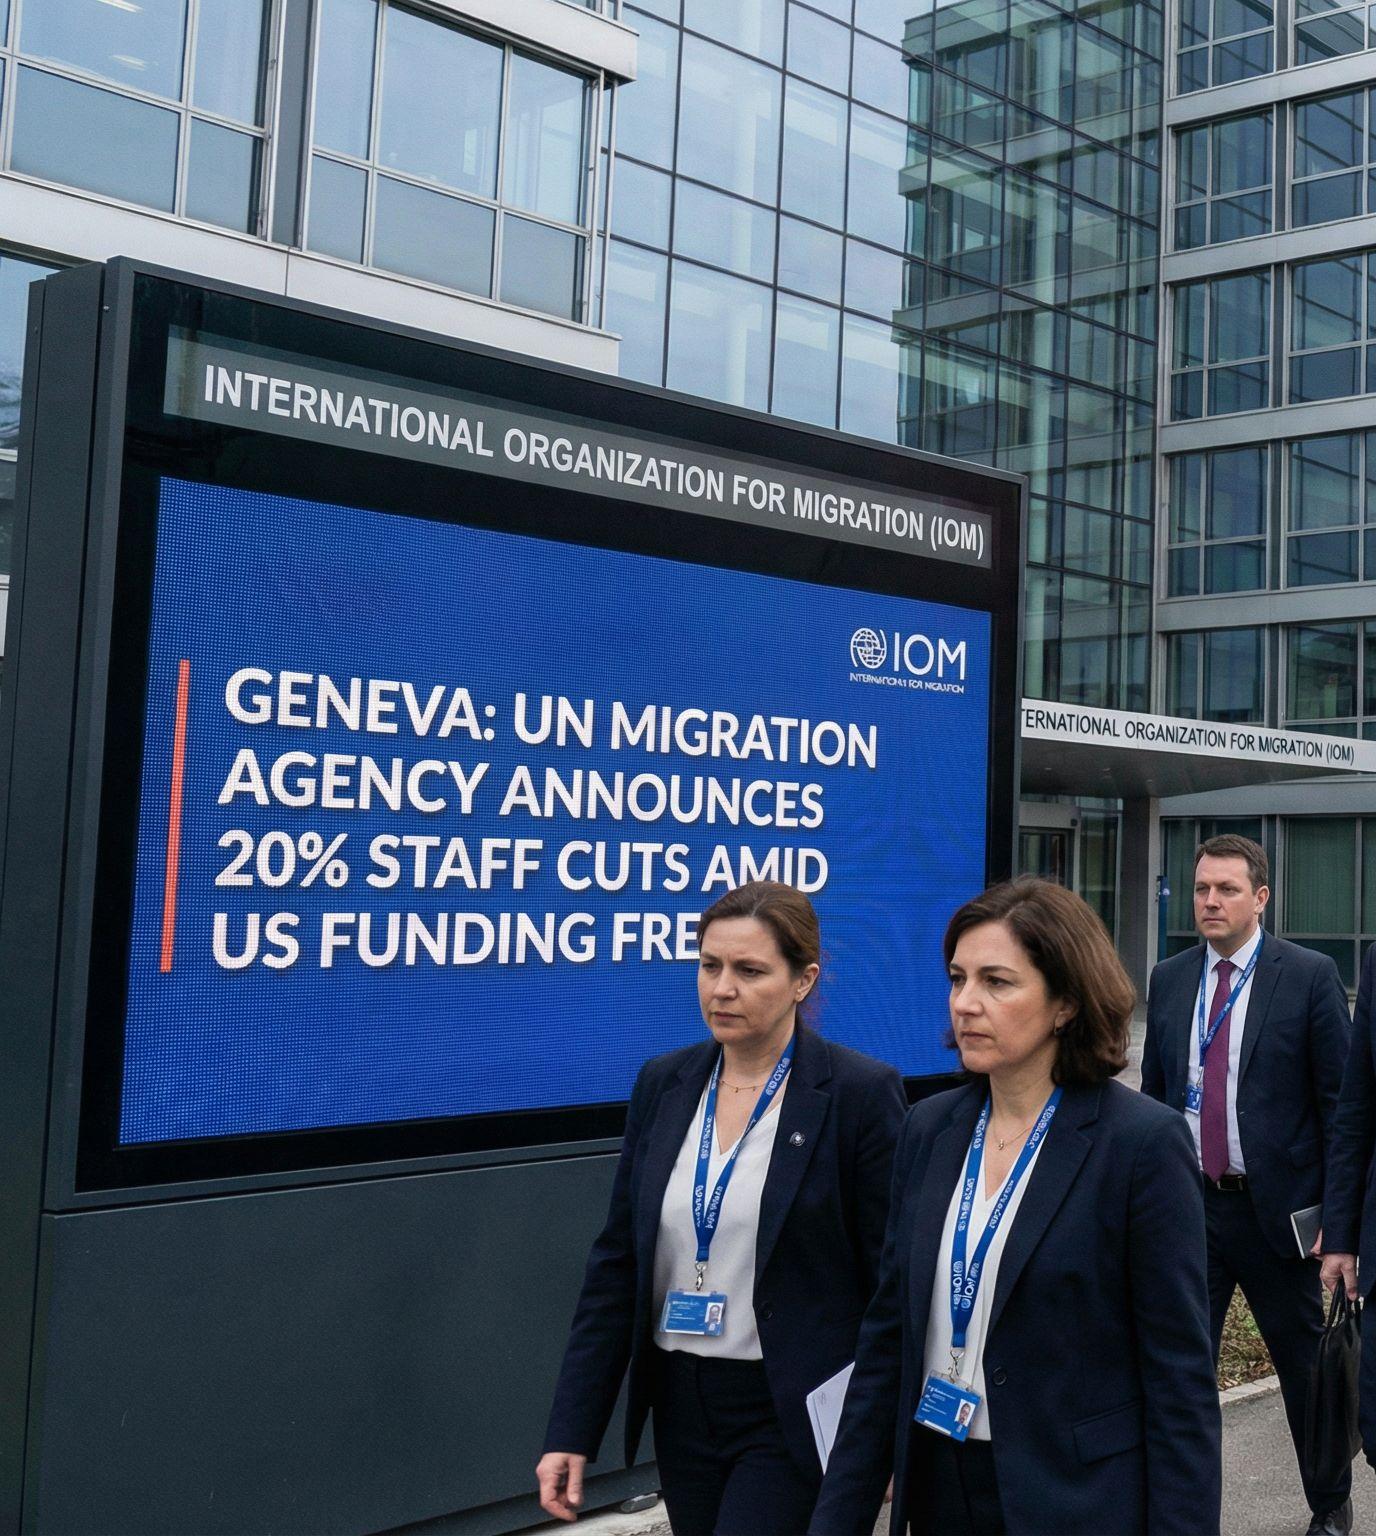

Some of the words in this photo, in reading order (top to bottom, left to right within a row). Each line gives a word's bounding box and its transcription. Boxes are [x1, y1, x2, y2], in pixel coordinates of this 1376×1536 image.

[204, 364, 494, 457] INTERNATIONAL
[503, 427, 724, 502] ORGANIZATION
[733, 474, 786, 515] FOR
[793, 487, 923, 541] MIGRATION
[930, 515, 984, 560] (IOM)
[894, 631, 966, 680] IOM
[225, 667, 496, 741] GENEVA:
[514, 692, 594, 748] UN
[610, 701, 877, 768] MIGRATION
[1021, 708, 1120, 738] ERNATIONAL
[1125, 719, 1226, 749] ORGANIZATION
[1230, 732, 1255, 751] FOR
[1258, 735, 1323, 758] MIGRATION
[1326, 742, 1355, 766] (IOM)
[217, 748, 489, 813] AGENCY
[499, 765, 824, 829] ANNOUNCES
[215, 829, 349, 888] 20%
[366, 834, 543, 889] STAFF
[557, 840, 690, 892] CUTS
[701, 844, 829, 893] AMID
[212, 912, 300, 969] US
[320, 912, 596, 967] FUNDING
